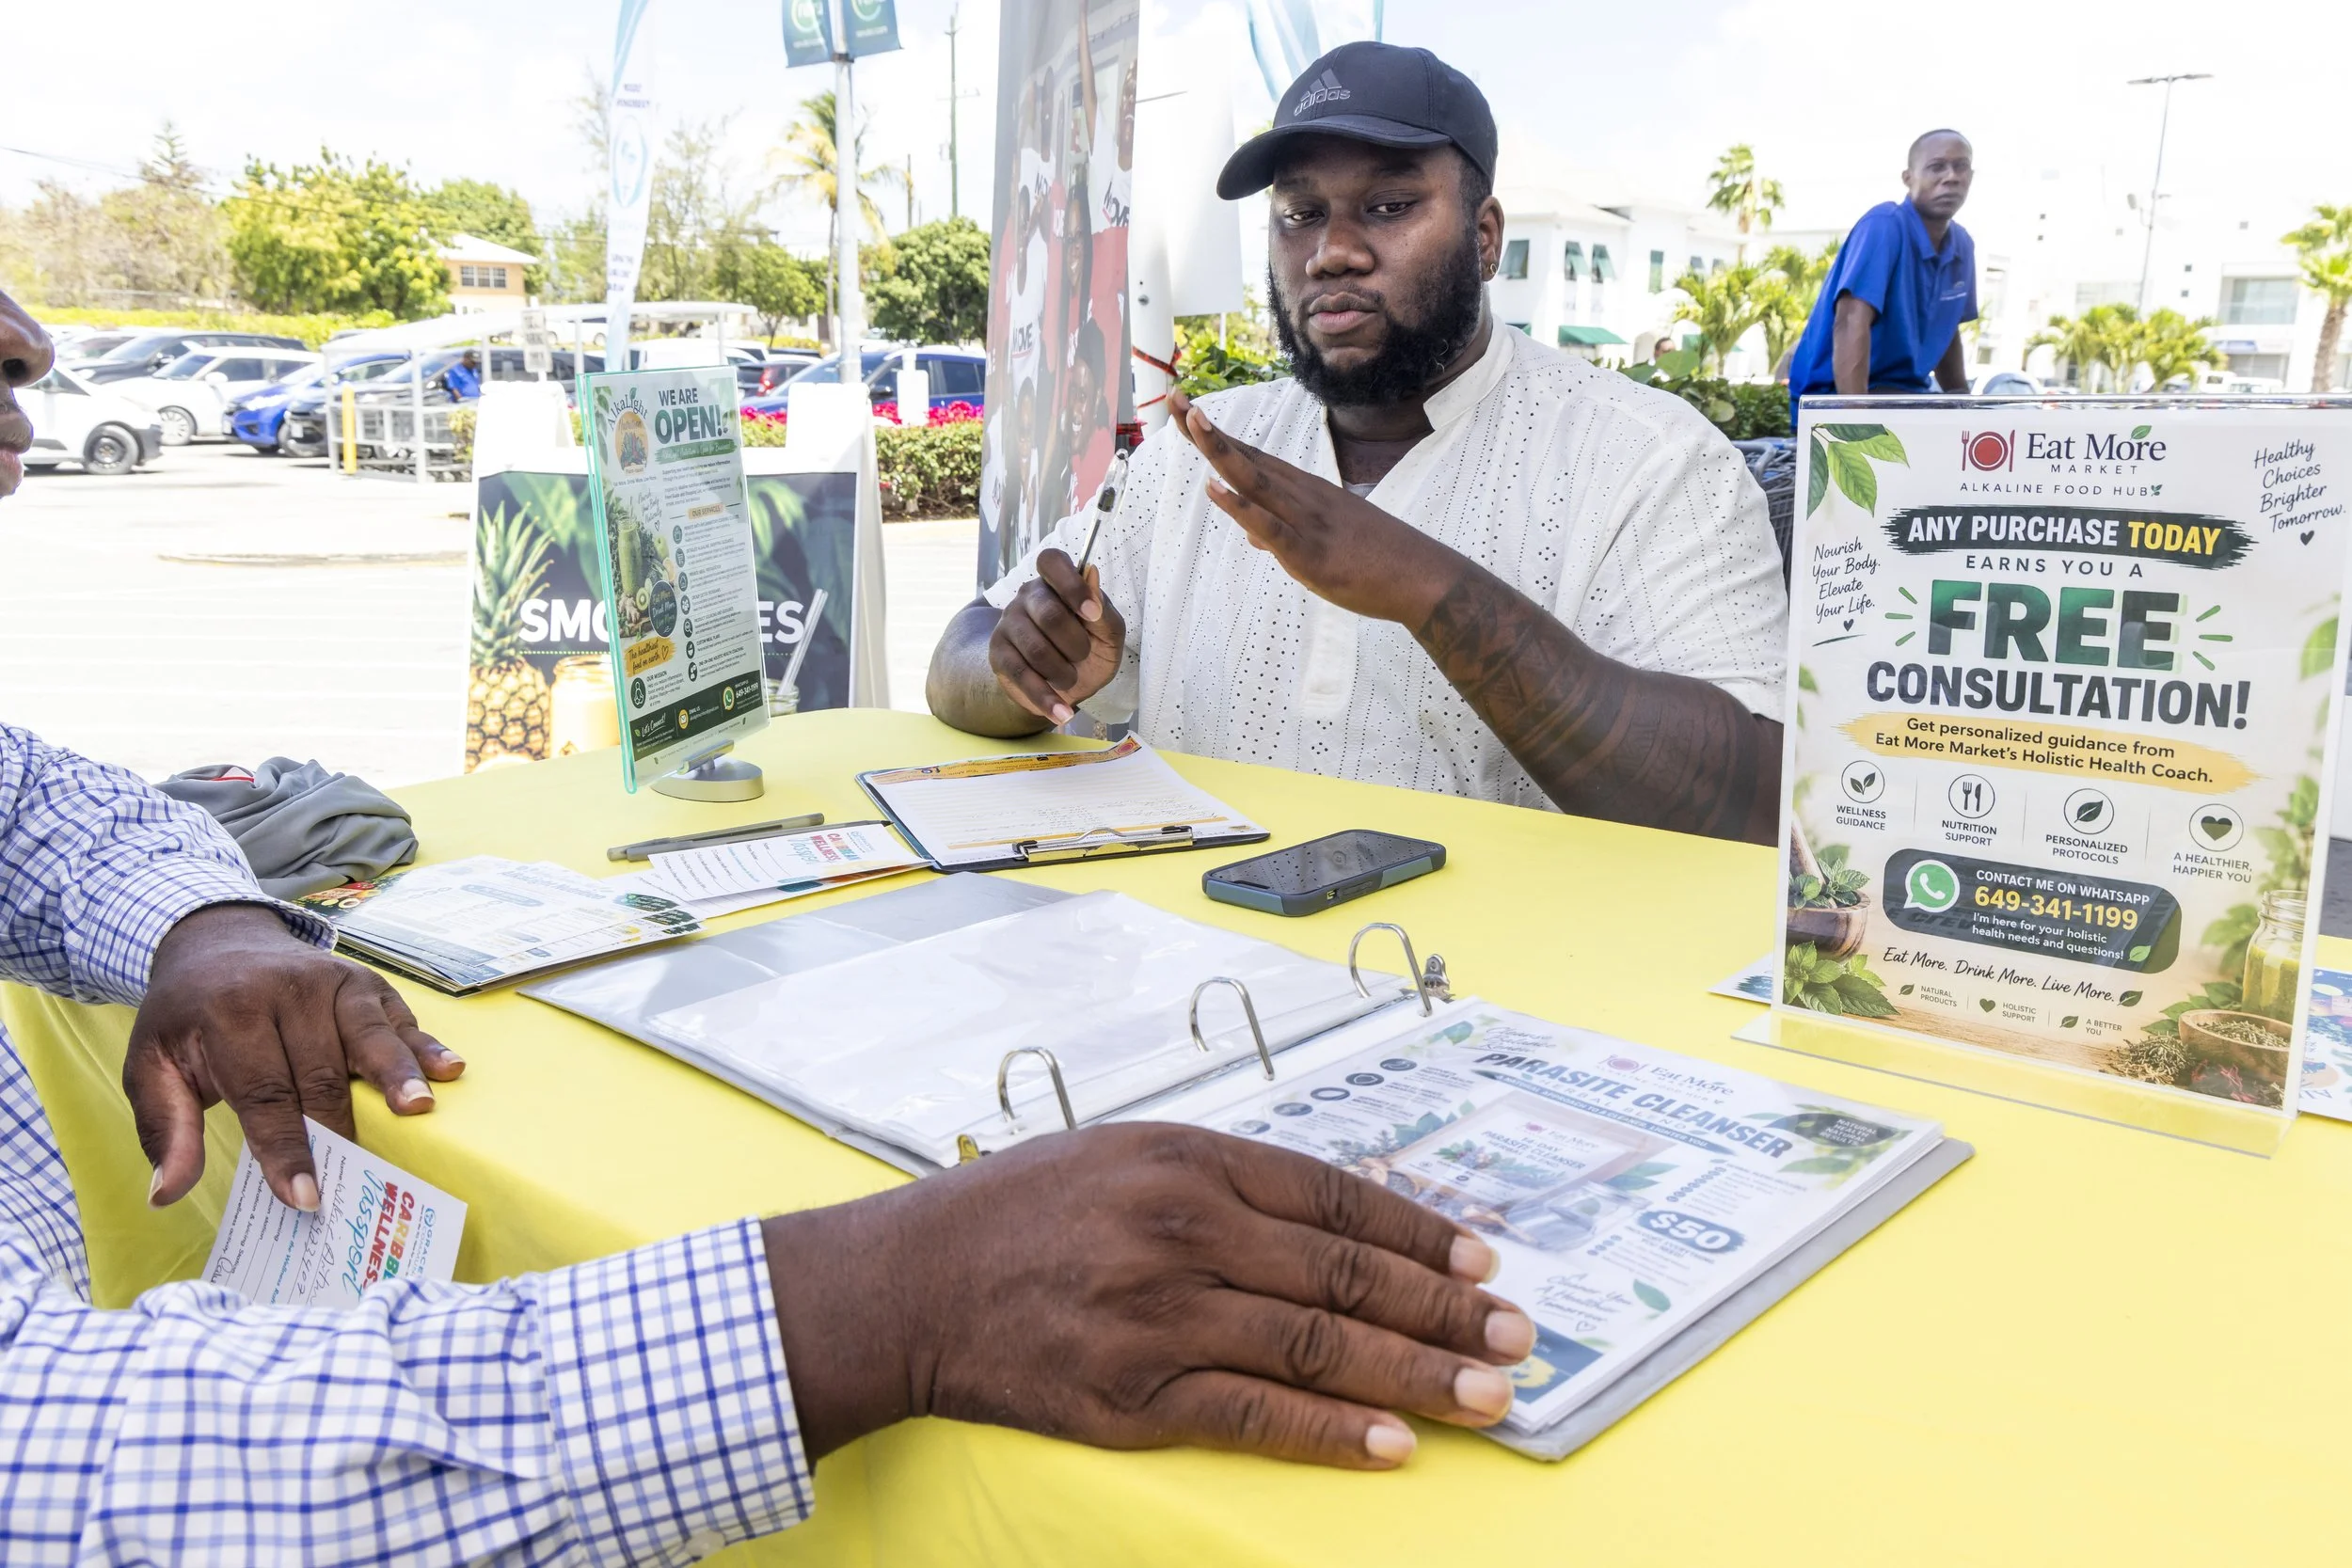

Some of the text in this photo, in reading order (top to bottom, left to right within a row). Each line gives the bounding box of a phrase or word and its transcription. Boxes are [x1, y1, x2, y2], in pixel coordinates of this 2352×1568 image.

[1295, 88, 1351, 117] adidas
[1012, 324, 1034, 351] MOVE
[659, 388, 699, 406] WE ARE
[608, 394, 648, 431] AlkaLight
[654, 404, 723, 444] OPEN!
[2026, 433, 2167, 461] Eat More
[2254, 438, 2315, 468] Healthy
[2051, 464, 2138, 474] MARKET
[2263, 464, 2321, 489] Choices
[1960, 483, 2148, 497] ALKALINE FOOD HUB
[2260, 483, 2328, 513] Brighter
[2269, 504, 2346, 532] Tomorrow.
[1814, 535, 1863, 562] Nourish
[1908, 515, 2221, 555] ANY PURCHASE TODAY
[1812, 553, 1881, 584] Your Body.
[1965, 555, 2143, 578] EARNS YOU A
[1819, 577, 1864, 600] Elevate
[1816, 594, 1875, 624] Your Life.
[1928, 578, 2183, 673] FREE
[645, 669, 667, 683] OUR MISSION
[1867, 660, 2251, 730] CONSULTATION!
[648, 711, 667, 731] Connect!
[1906, 718, 2175, 758] Get personalized guidance from
[1876, 733, 2214, 784] Eat More Market's Holistic Health Coach.
[1836, 805, 1886, 819] WELLNESS
[1836, 816, 1885, 831] GUIDANCE
[1942, 820, 1997, 835] NUTRITION
[1945, 832, 1993, 847] SUPPORT
[809, 834, 841, 862] WELLNESS
[2045, 834, 2128, 853] PERSONALIZED
[2052, 848, 2119, 864] PROTOCOLS
[2172, 865, 2251, 884] HAPPIER YOU
[2173, 852, 2252, 872] A HEALTHIER,
[1976, 870, 2150, 906] CONTACT ME ON WHATSAPP
[1974, 885, 2138, 931] 649-341-1199
[1973, 912, 1990, 924] I'm
[1993, 915, 2017, 928] here
[2020, 919, 2036, 931] for
[2039, 926, 2064, 938] your
[2067, 926, 2107, 943] holistic
[1972, 926, 2124, 960] health needs and questions!
[1883, 946, 2115, 1003] Eat More. Drink More. Live More.
[1920, 985, 1952, 998] NATURAL
[1920, 993, 1957, 1007] PRODUCTS
[2002, 1002, 2037, 1015] HOLISTIC
[2002, 1010, 2035, 1023] SUPPORT
[2086, 1027, 2102, 1036] YOU
[2094, 1020, 2122, 1032] BETTER
[1650, 1067, 1735, 1096] Eat More
[1473, 1053, 1636, 1100] PARASITE
[1631, 1093, 1793, 1159] CLEANSER
[1539, 1079, 1687, 1130] HERBAL BLEND
[1544, 1088, 1587, 1109] APPROACH
[1650, 1125, 1687, 1142] LIGHTER
[1825, 1127, 1866, 1142] NATURAL
[1832, 1123, 1869, 1138] HEALTH
[1836, 1118, 1878, 1135] NATURAL
[323, 1145, 332, 1169] Phone
[1481, 1131, 1587, 1170] PARASITE CLEANSER
[231, 1171, 252, 1227] fitness/wellness
[222, 1227, 235, 1254] activity
[240, 1222, 252, 1247] Juicing
[258, 1215, 271, 1241] station
[291, 1219, 300, 1242] enter
[342, 1169, 388, 1303] Passport
[1649, 1212, 1731, 1250] $50
[230, 1249, 245, 1275] Station
[418, 1228, 433, 1277] GRACE
[278, 1254, 292, 1284] Wellness
